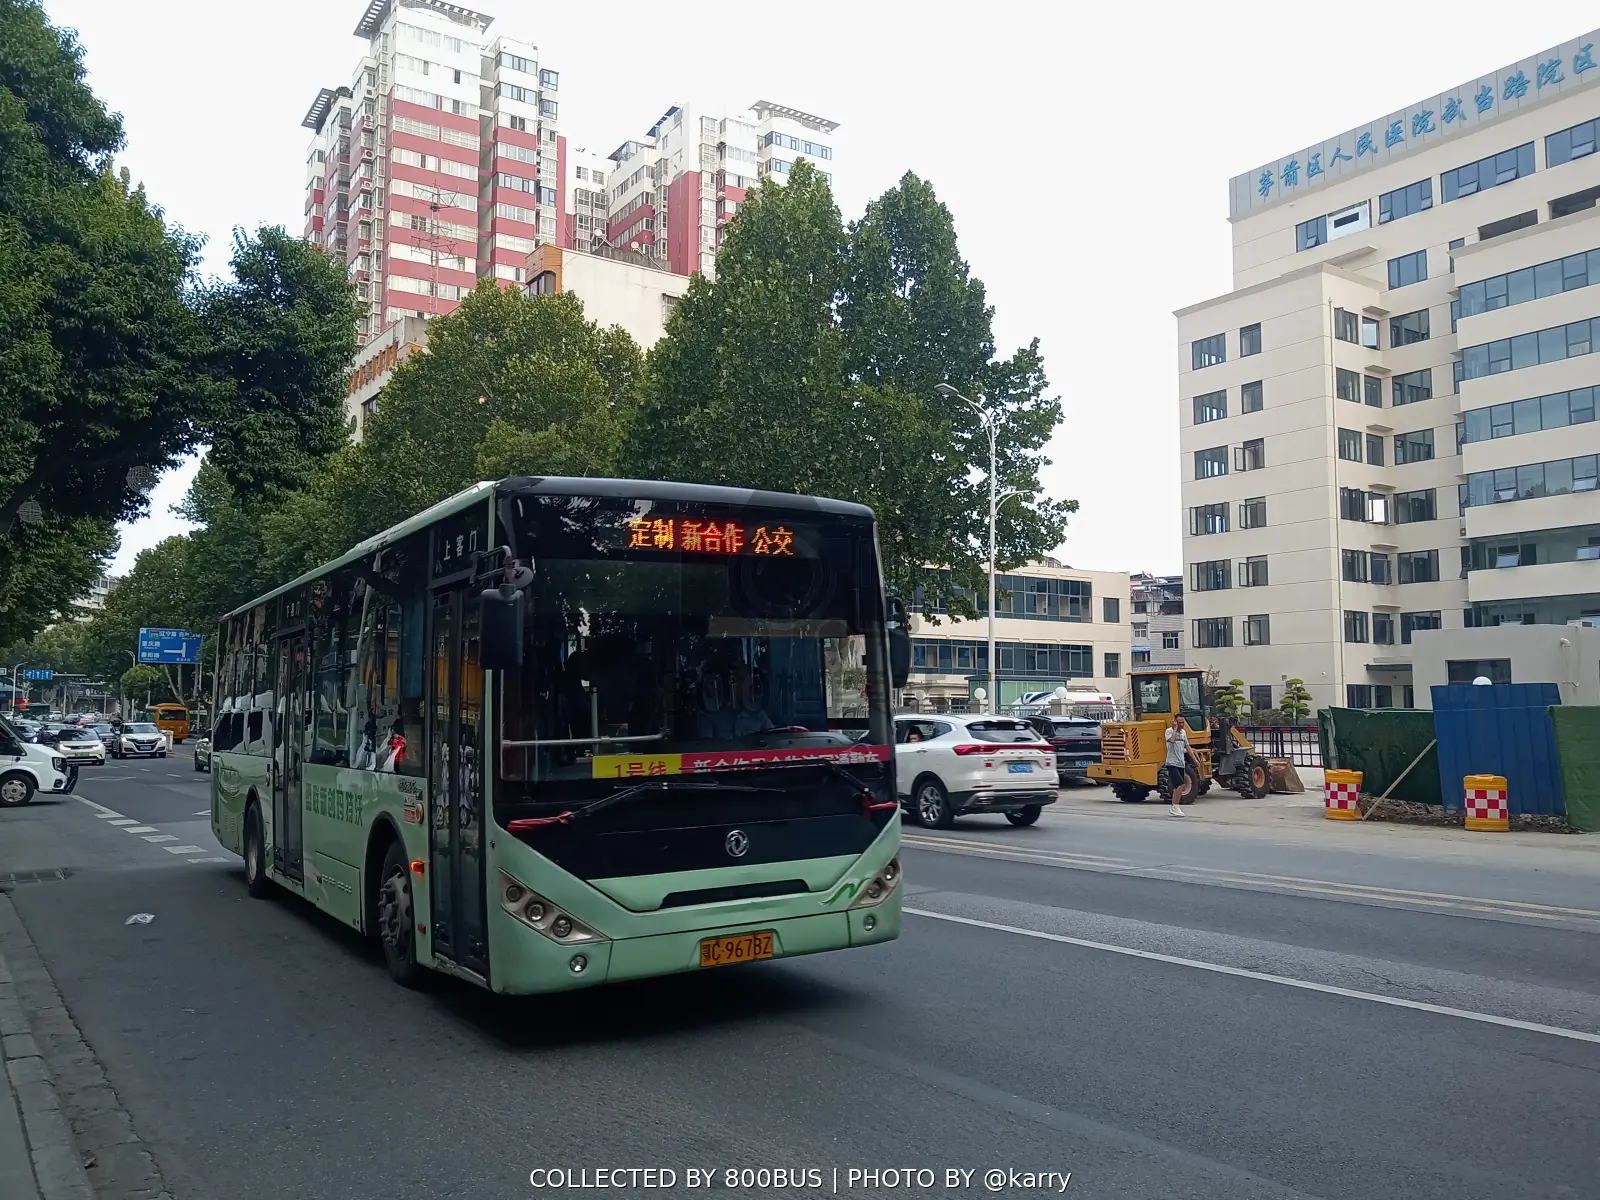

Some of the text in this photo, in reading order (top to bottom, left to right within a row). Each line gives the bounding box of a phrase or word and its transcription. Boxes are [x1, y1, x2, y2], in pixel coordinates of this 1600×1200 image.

[1258, 43, 1597, 197] 茅箭区人民医院武当路院区
[444, 530, 477, 561] 上客门
[628, 517, 794, 555] 定制 新合作 公交
[614, 761, 668, 777] 1号线
